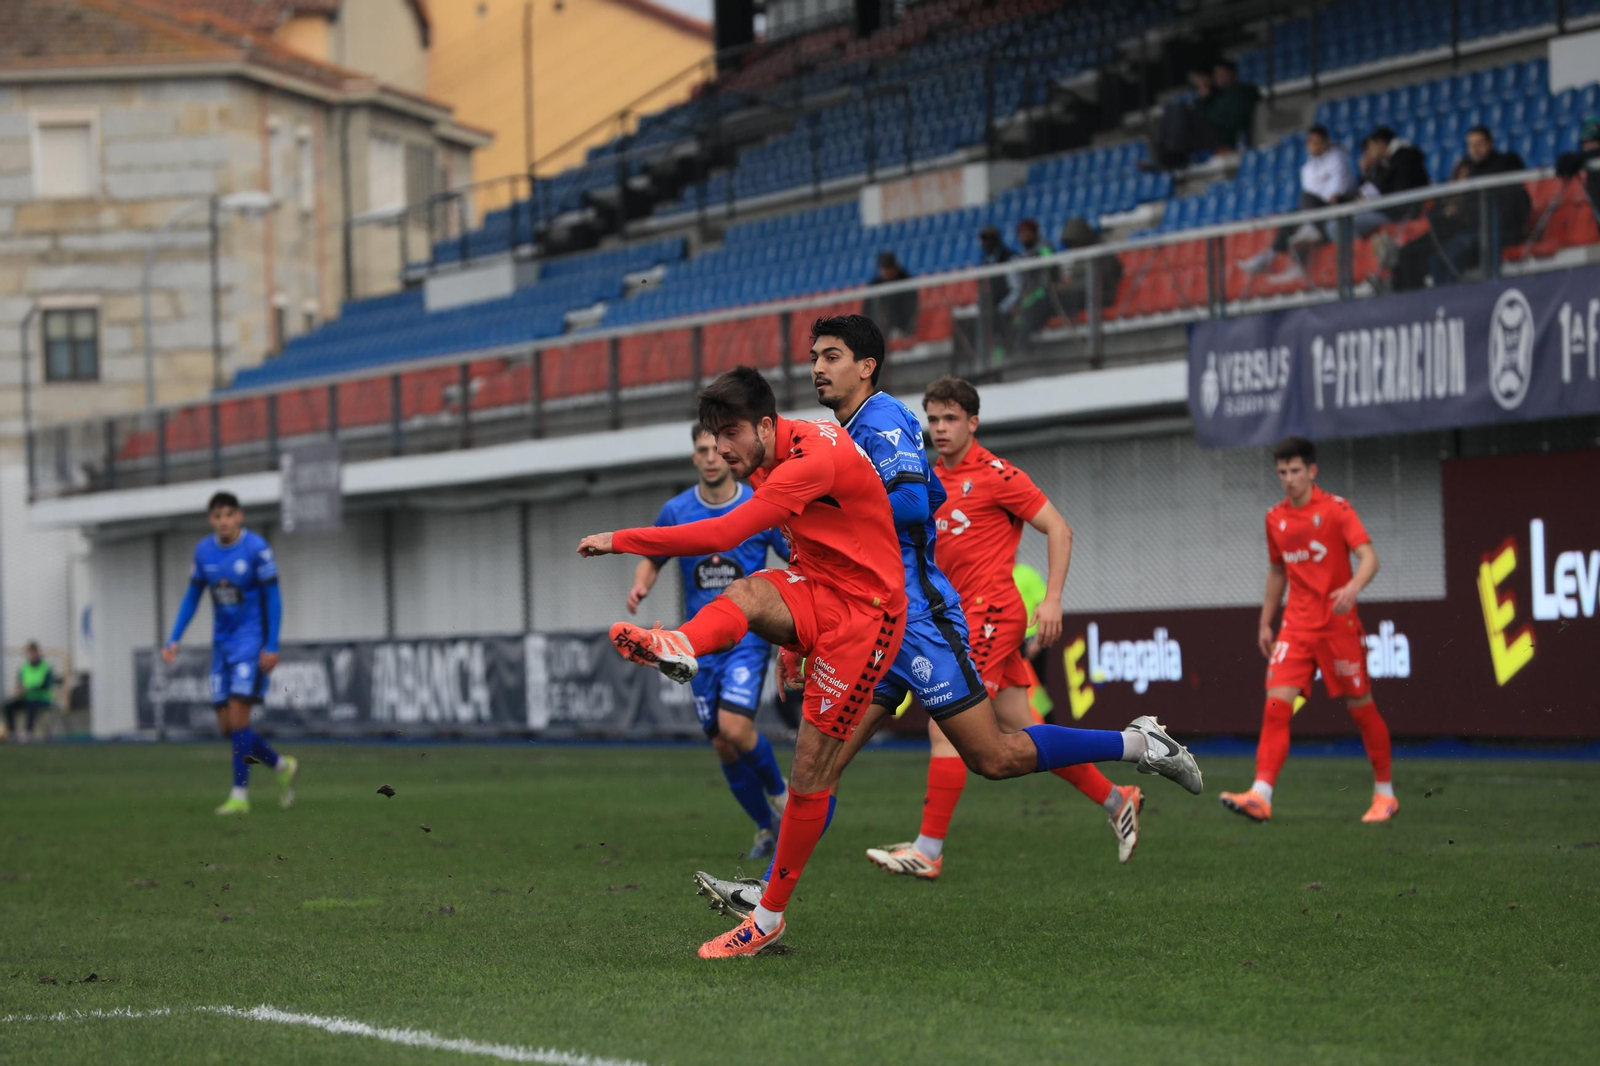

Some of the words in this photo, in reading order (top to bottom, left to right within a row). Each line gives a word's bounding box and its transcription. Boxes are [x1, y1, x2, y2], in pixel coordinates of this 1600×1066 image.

[1219, 345, 1290, 394] VERSUS
[1335, 306, 1466, 409] FEDERACIÓN
[1529, 518, 1600, 621] Lev
[370, 641, 492, 722] ABANCA
[813, 664, 849, 691] Universidad
[815, 656, 836, 675] Clínica
[816, 677, 842, 698] Navarra
[1087, 621, 1182, 694] Levagalia
